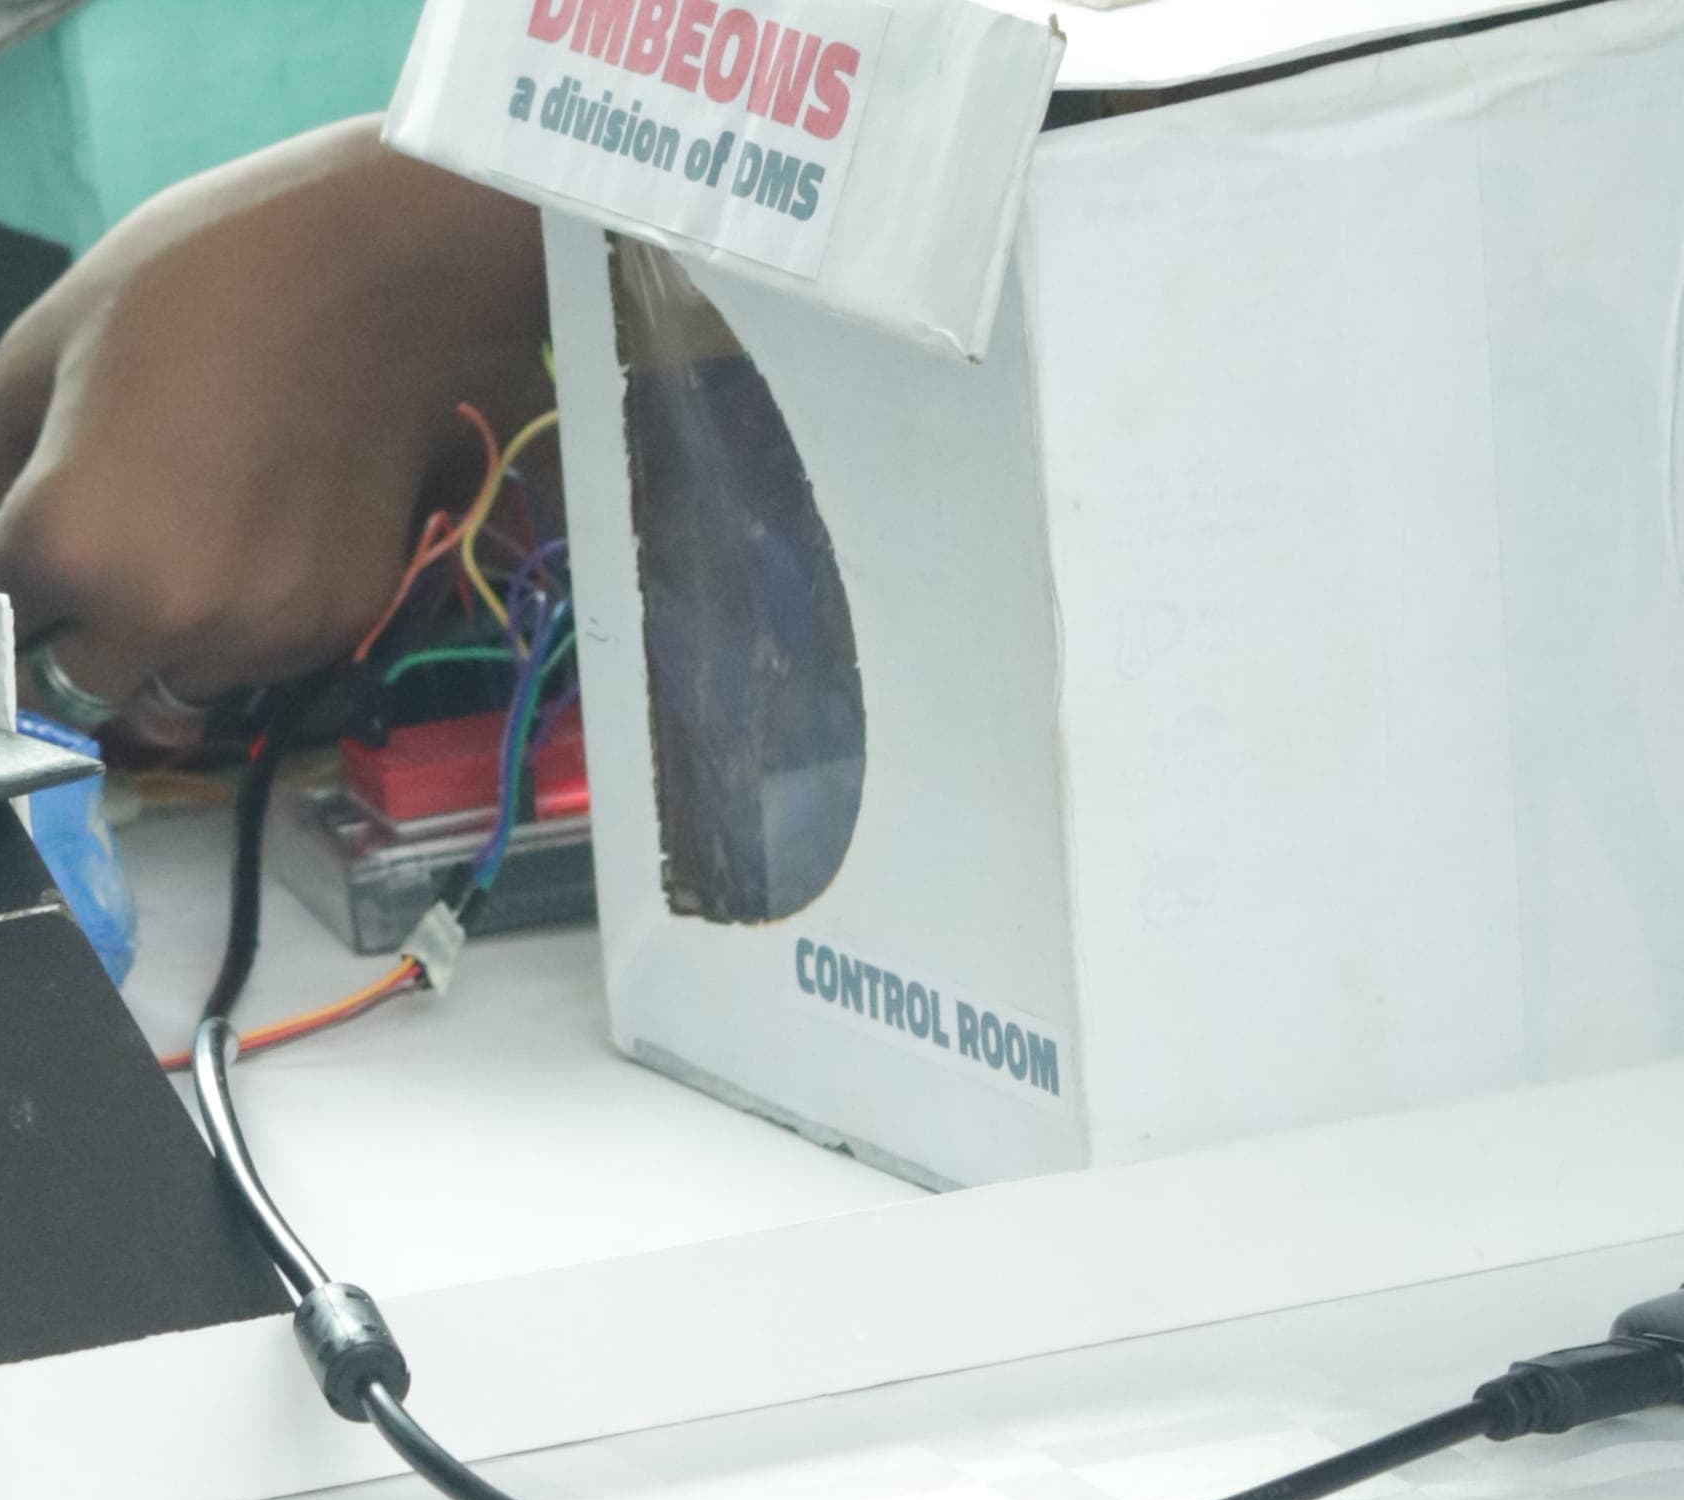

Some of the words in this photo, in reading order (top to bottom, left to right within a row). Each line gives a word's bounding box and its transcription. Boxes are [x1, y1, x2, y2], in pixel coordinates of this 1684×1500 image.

[508, 75, 537, 122] a
[540, 75, 681, 172] division
[683, 130, 735, 188] of
[730, 141, 825, 221] DMS
[796, 937, 950, 1049] CONTROL
[957, 1000, 1060, 1096] ROOM
